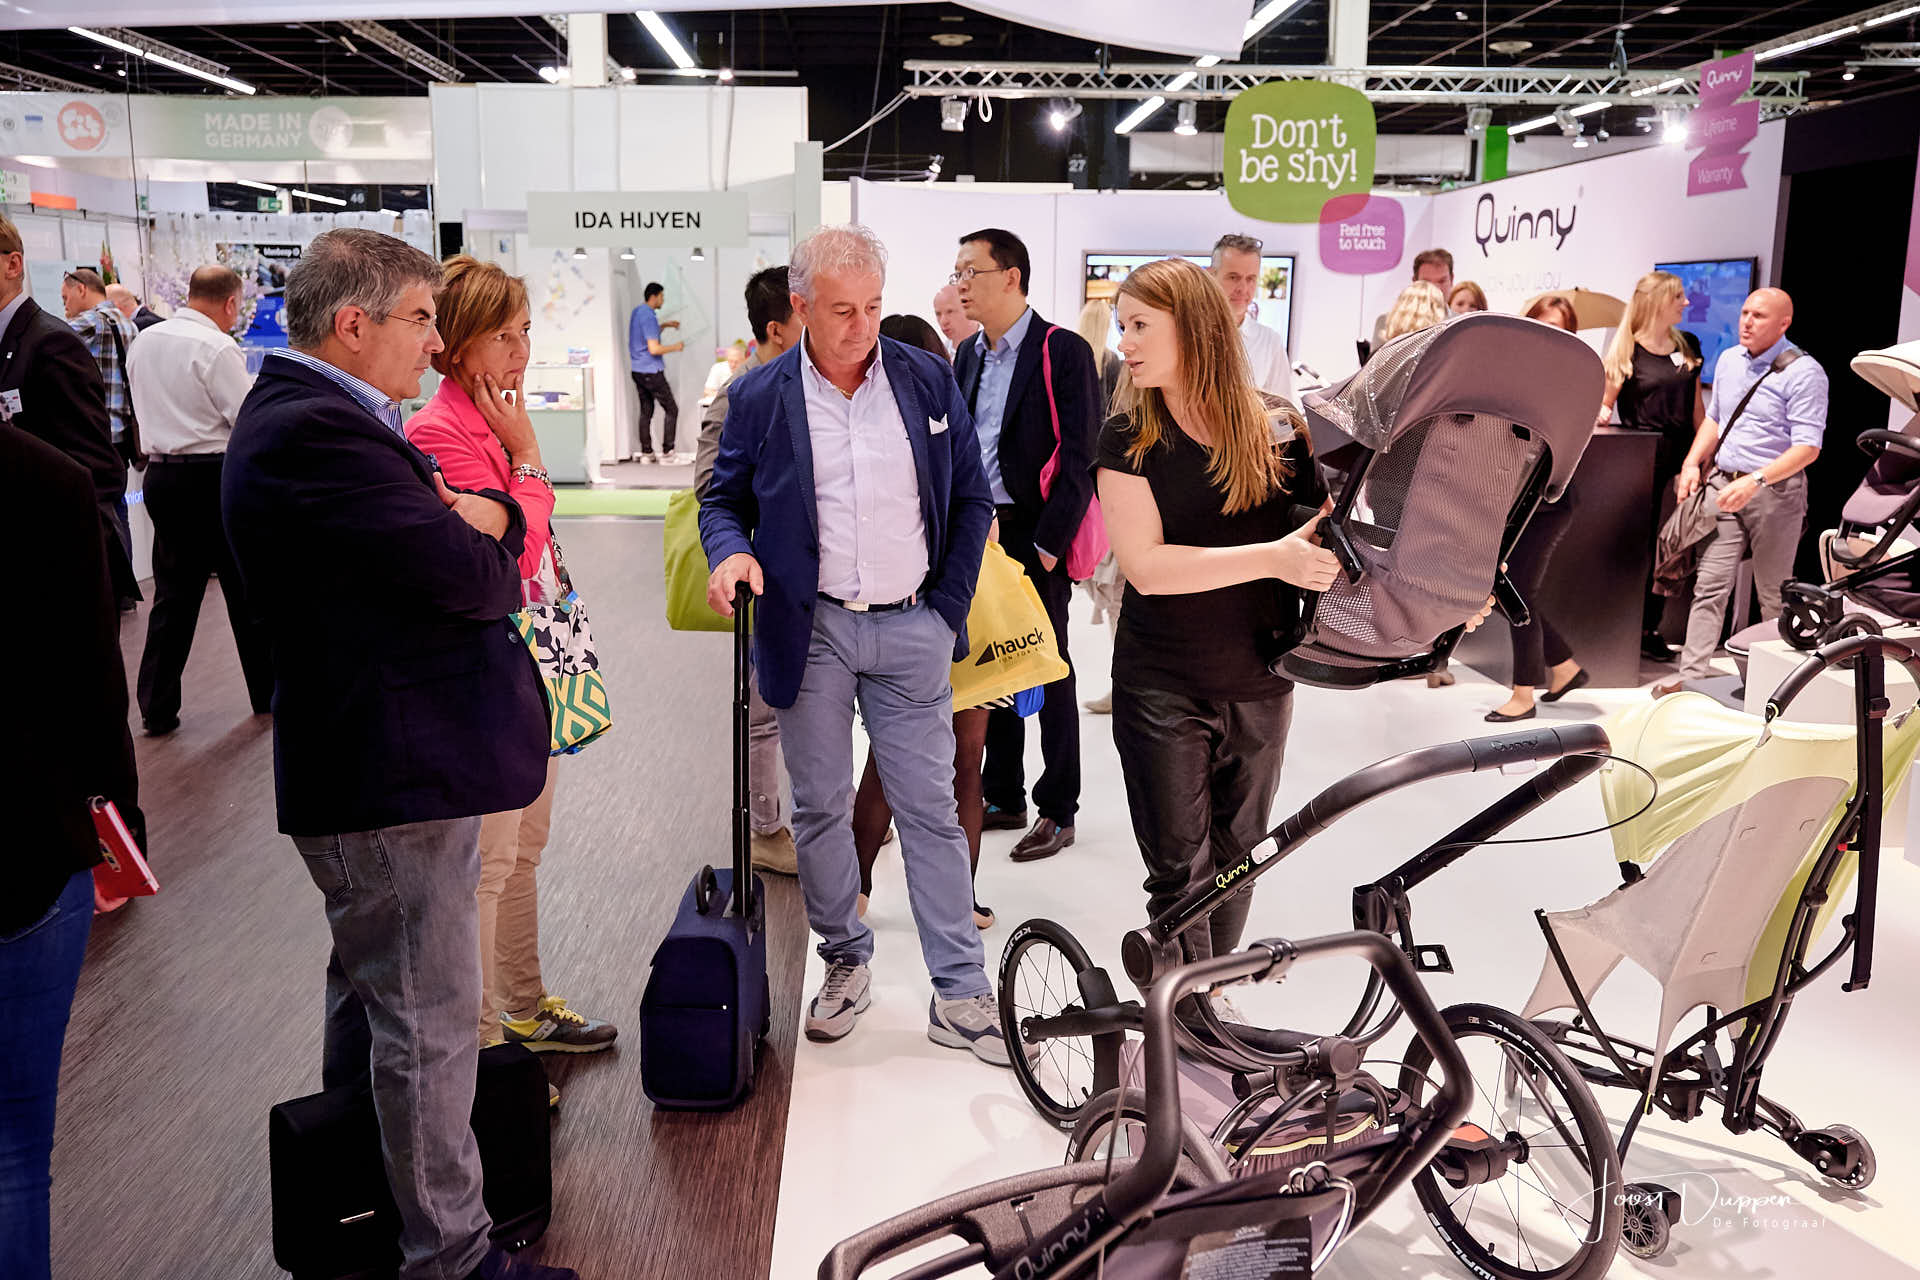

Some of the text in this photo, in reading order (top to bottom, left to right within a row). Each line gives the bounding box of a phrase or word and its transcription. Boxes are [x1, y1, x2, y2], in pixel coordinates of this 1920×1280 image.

[1706, 65, 1745, 88] Quinny
[205, 111, 302, 131] MADE IN
[1251, 113, 1347, 149] Don't
[205, 131, 302, 149] GERMANY
[1068, 159, 1086, 172] 27
[1239, 148, 1357, 190] be shy!
[575, 211, 700, 229] IDA HIJYEN
[1340, 223, 1386, 237] Feel free
[1475, 192, 1576, 258] Quinny
[1339, 237, 1386, 250] to touch
[993, 627, 1045, 659] hauck
[1215, 855, 1250, 889] Quinny
[1014, 1210, 1090, 1280] Quinny
